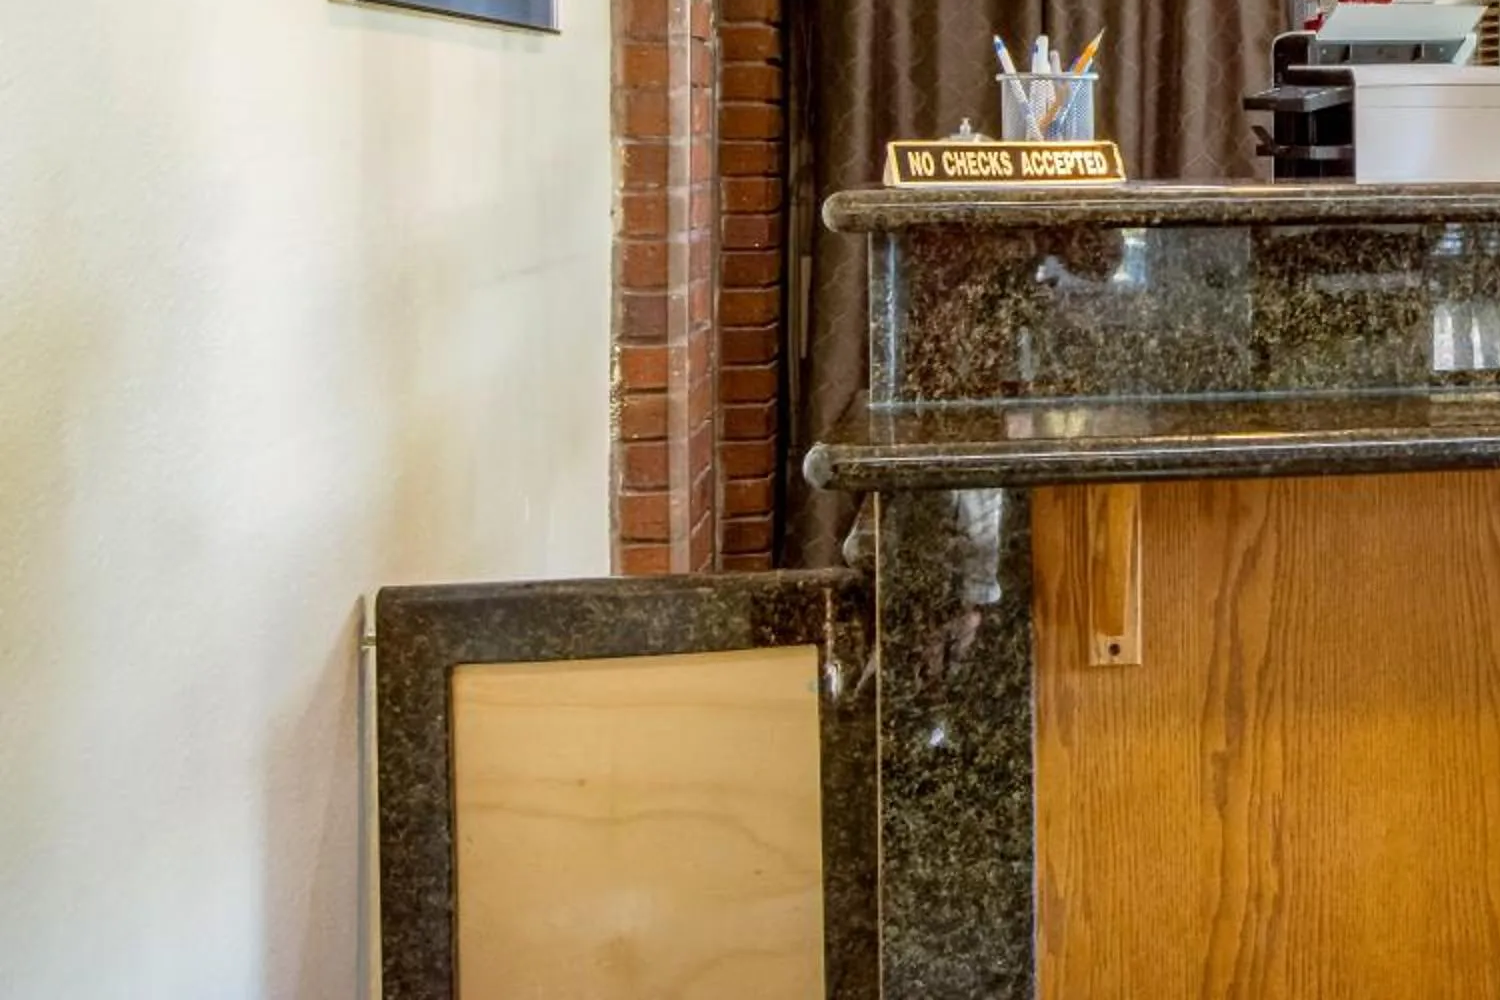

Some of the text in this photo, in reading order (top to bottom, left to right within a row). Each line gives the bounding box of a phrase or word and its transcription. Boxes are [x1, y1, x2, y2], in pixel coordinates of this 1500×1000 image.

[907, 150, 1109, 177] NO CHECKS ACCEPTED
